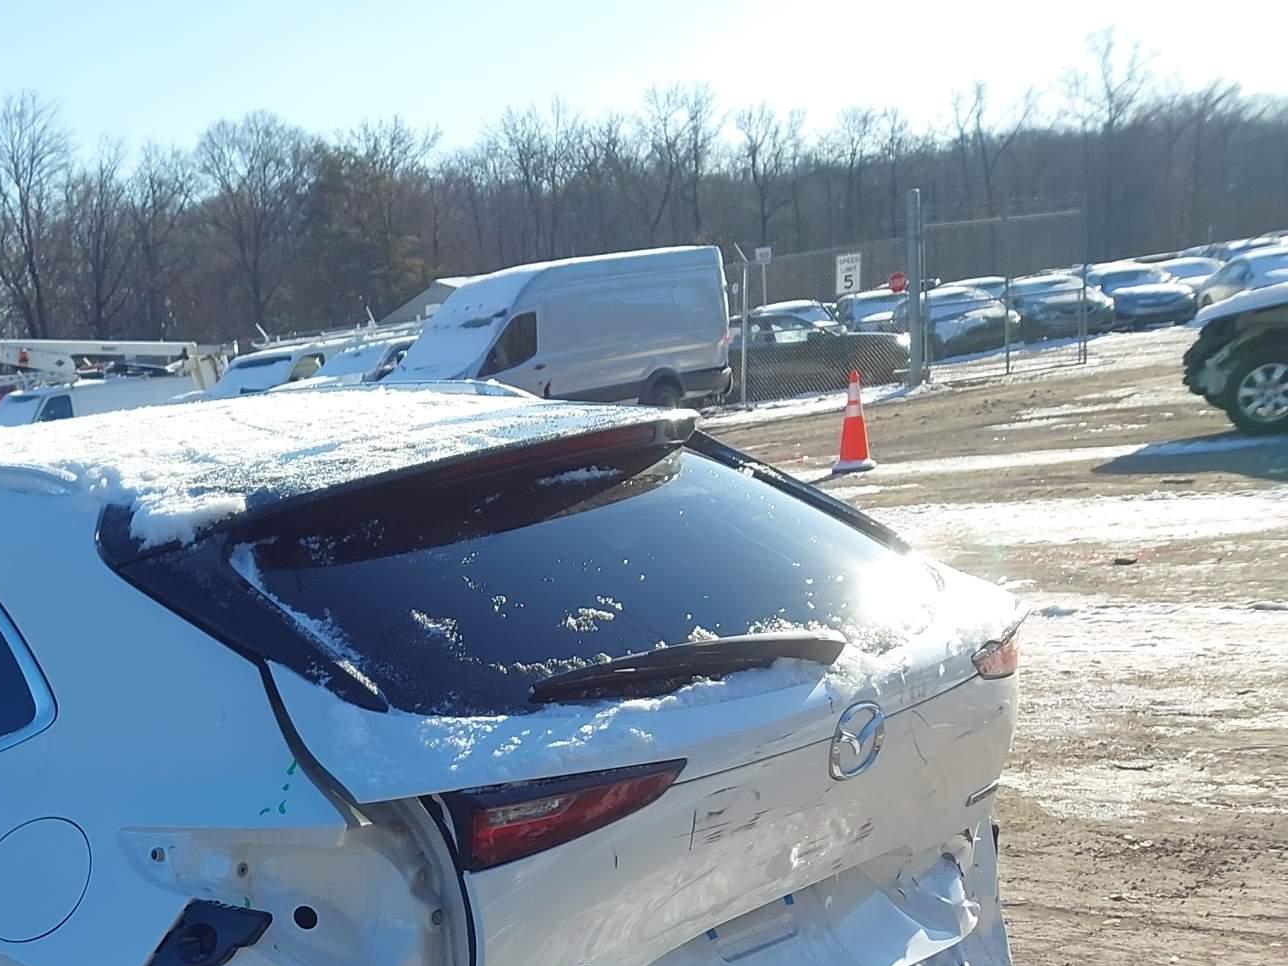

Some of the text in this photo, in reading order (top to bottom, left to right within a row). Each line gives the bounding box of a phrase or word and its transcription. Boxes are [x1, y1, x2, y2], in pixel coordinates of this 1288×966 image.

[839, 255, 860, 265] SPEED
[840, 265, 857, 273] LIMIT
[844, 274, 854, 289] 5
